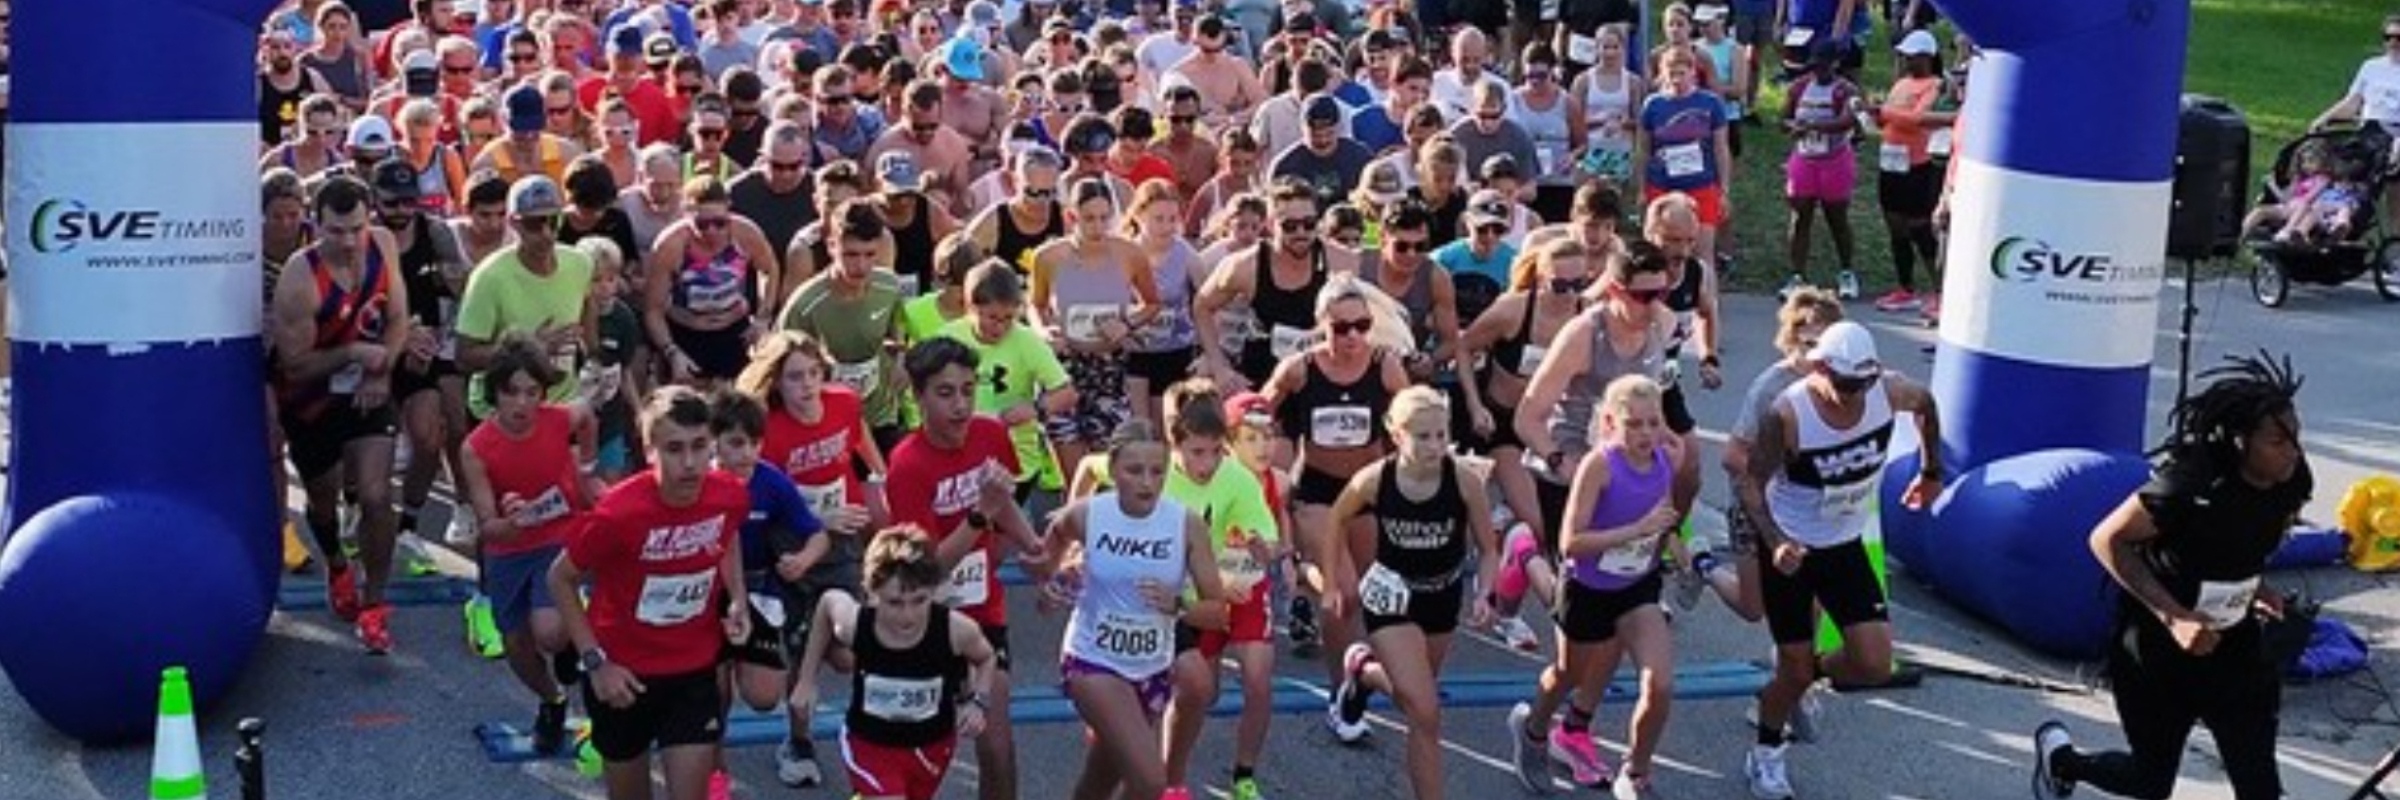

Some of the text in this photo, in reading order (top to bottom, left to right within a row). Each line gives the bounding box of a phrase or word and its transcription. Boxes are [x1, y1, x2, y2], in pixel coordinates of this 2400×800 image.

[55, 211, 245, 240] SVE TIMING
[2016, 250, 2111, 281] SVE
[1096, 533, 1172, 559] NIKE
[1095, 622, 1157, 655] 2008
